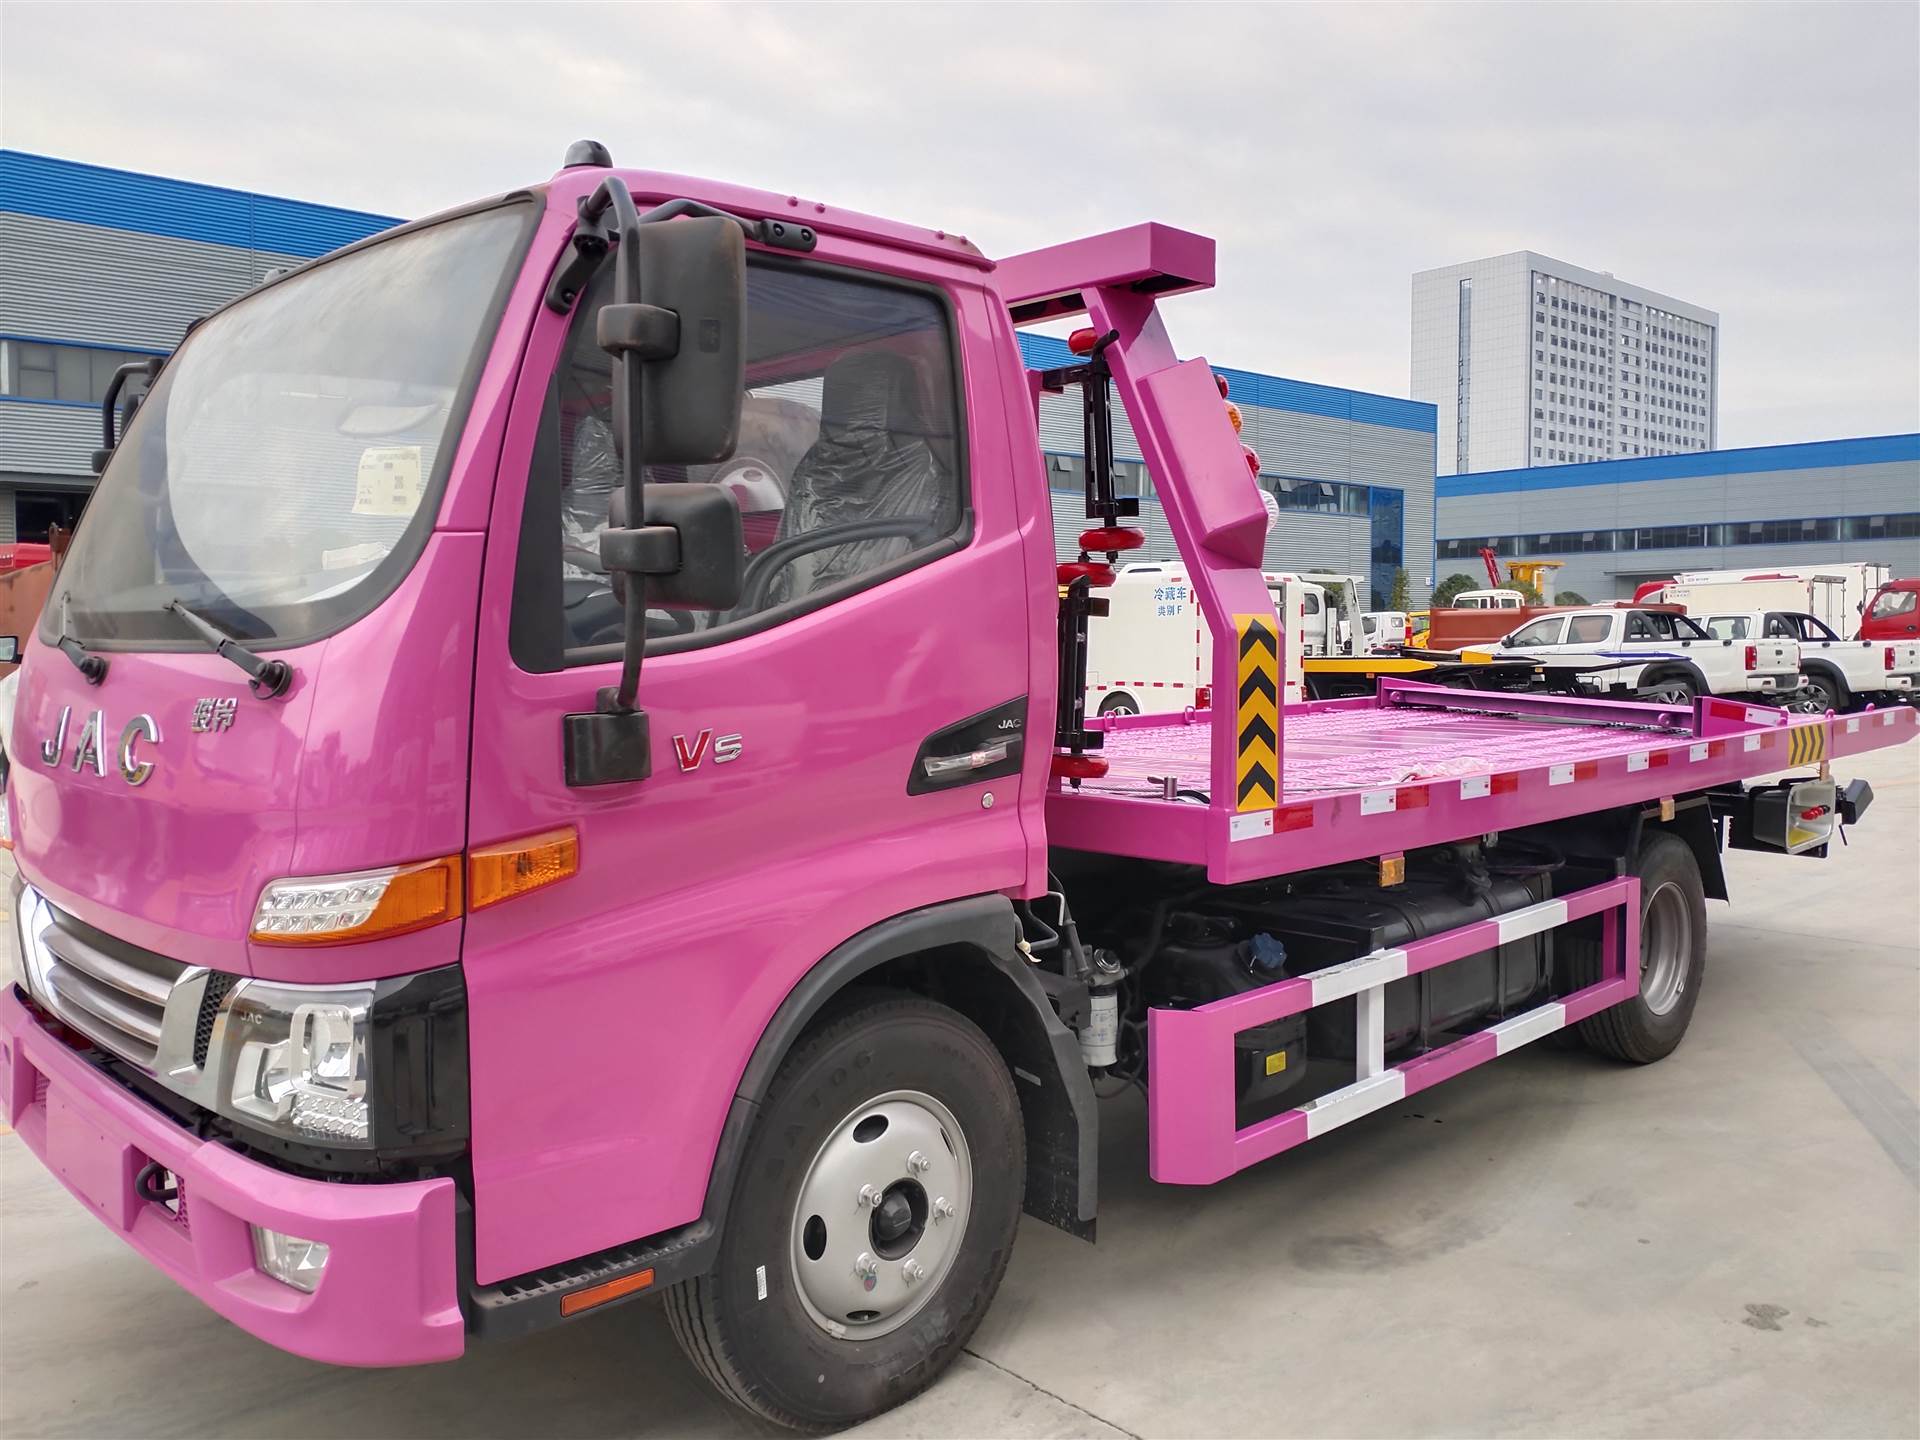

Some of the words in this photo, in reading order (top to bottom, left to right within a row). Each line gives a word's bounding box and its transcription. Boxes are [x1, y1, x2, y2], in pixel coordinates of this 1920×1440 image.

[1154, 586, 1187, 601] 冷藏车
[997, 718, 1022, 729] JAC
[41, 705, 159, 787] JAC
[240, 1010, 263, 1025] JAC
